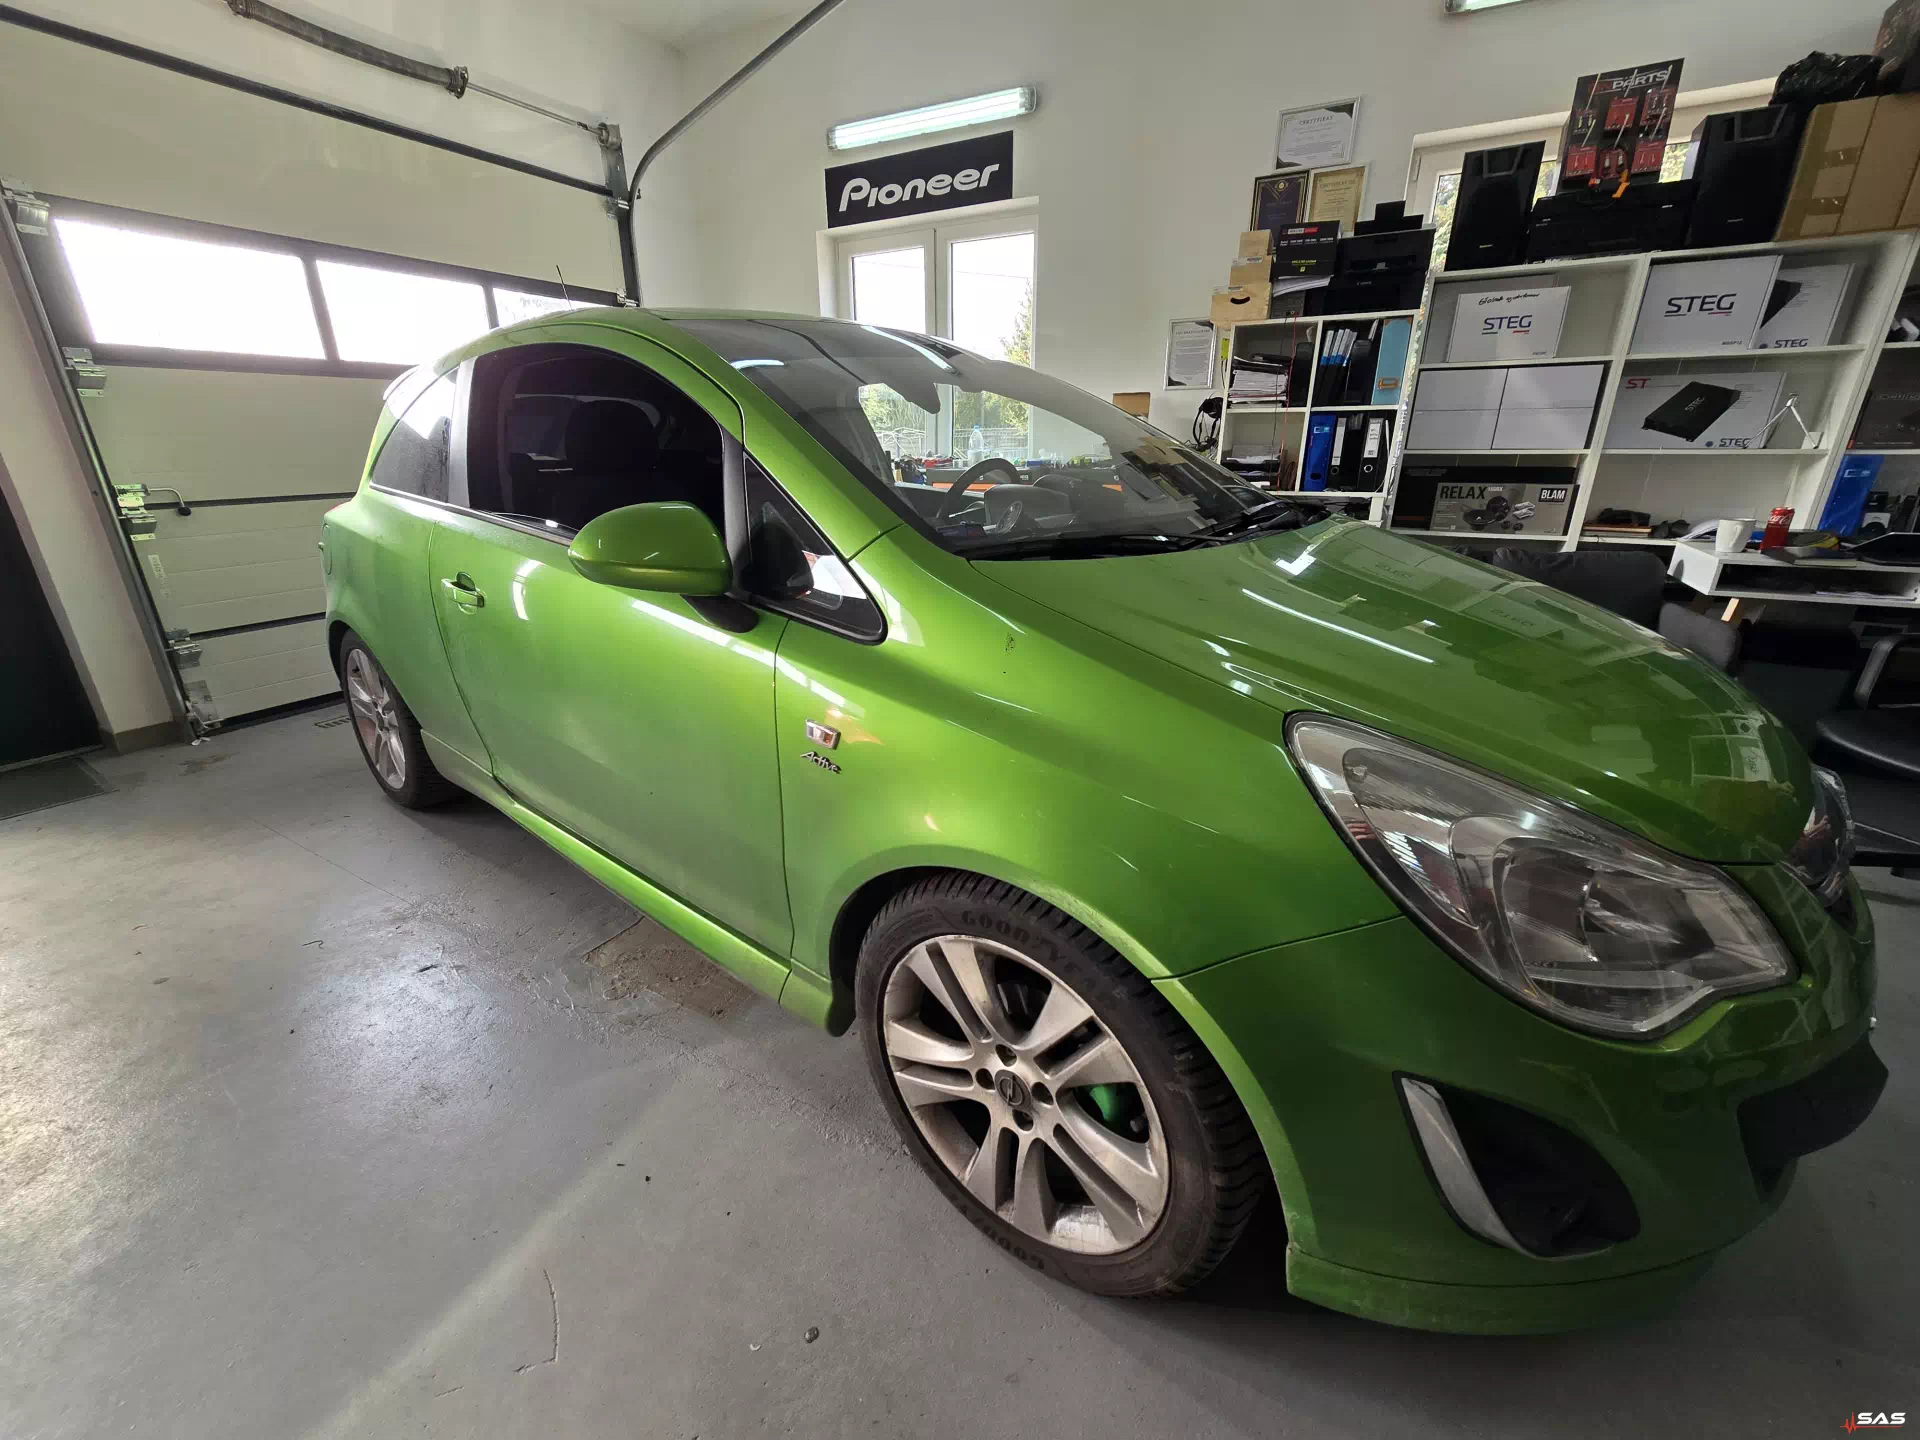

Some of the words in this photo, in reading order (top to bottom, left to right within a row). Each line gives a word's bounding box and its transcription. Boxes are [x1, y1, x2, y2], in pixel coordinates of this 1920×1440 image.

[1612, 69, 1668, 90] PARTS
[839, 164, 1000, 212] Pioneer
[1665, 293, 1738, 314] STEG
[1482, 314, 1533, 331] STEG
[1774, 339, 1809, 348] STEG
[1625, 378, 1651, 389] ST
[1440, 485, 1488, 500] RELAX
[1541, 489, 1566, 500] BLAM
[800, 751, 842, 774] Active
